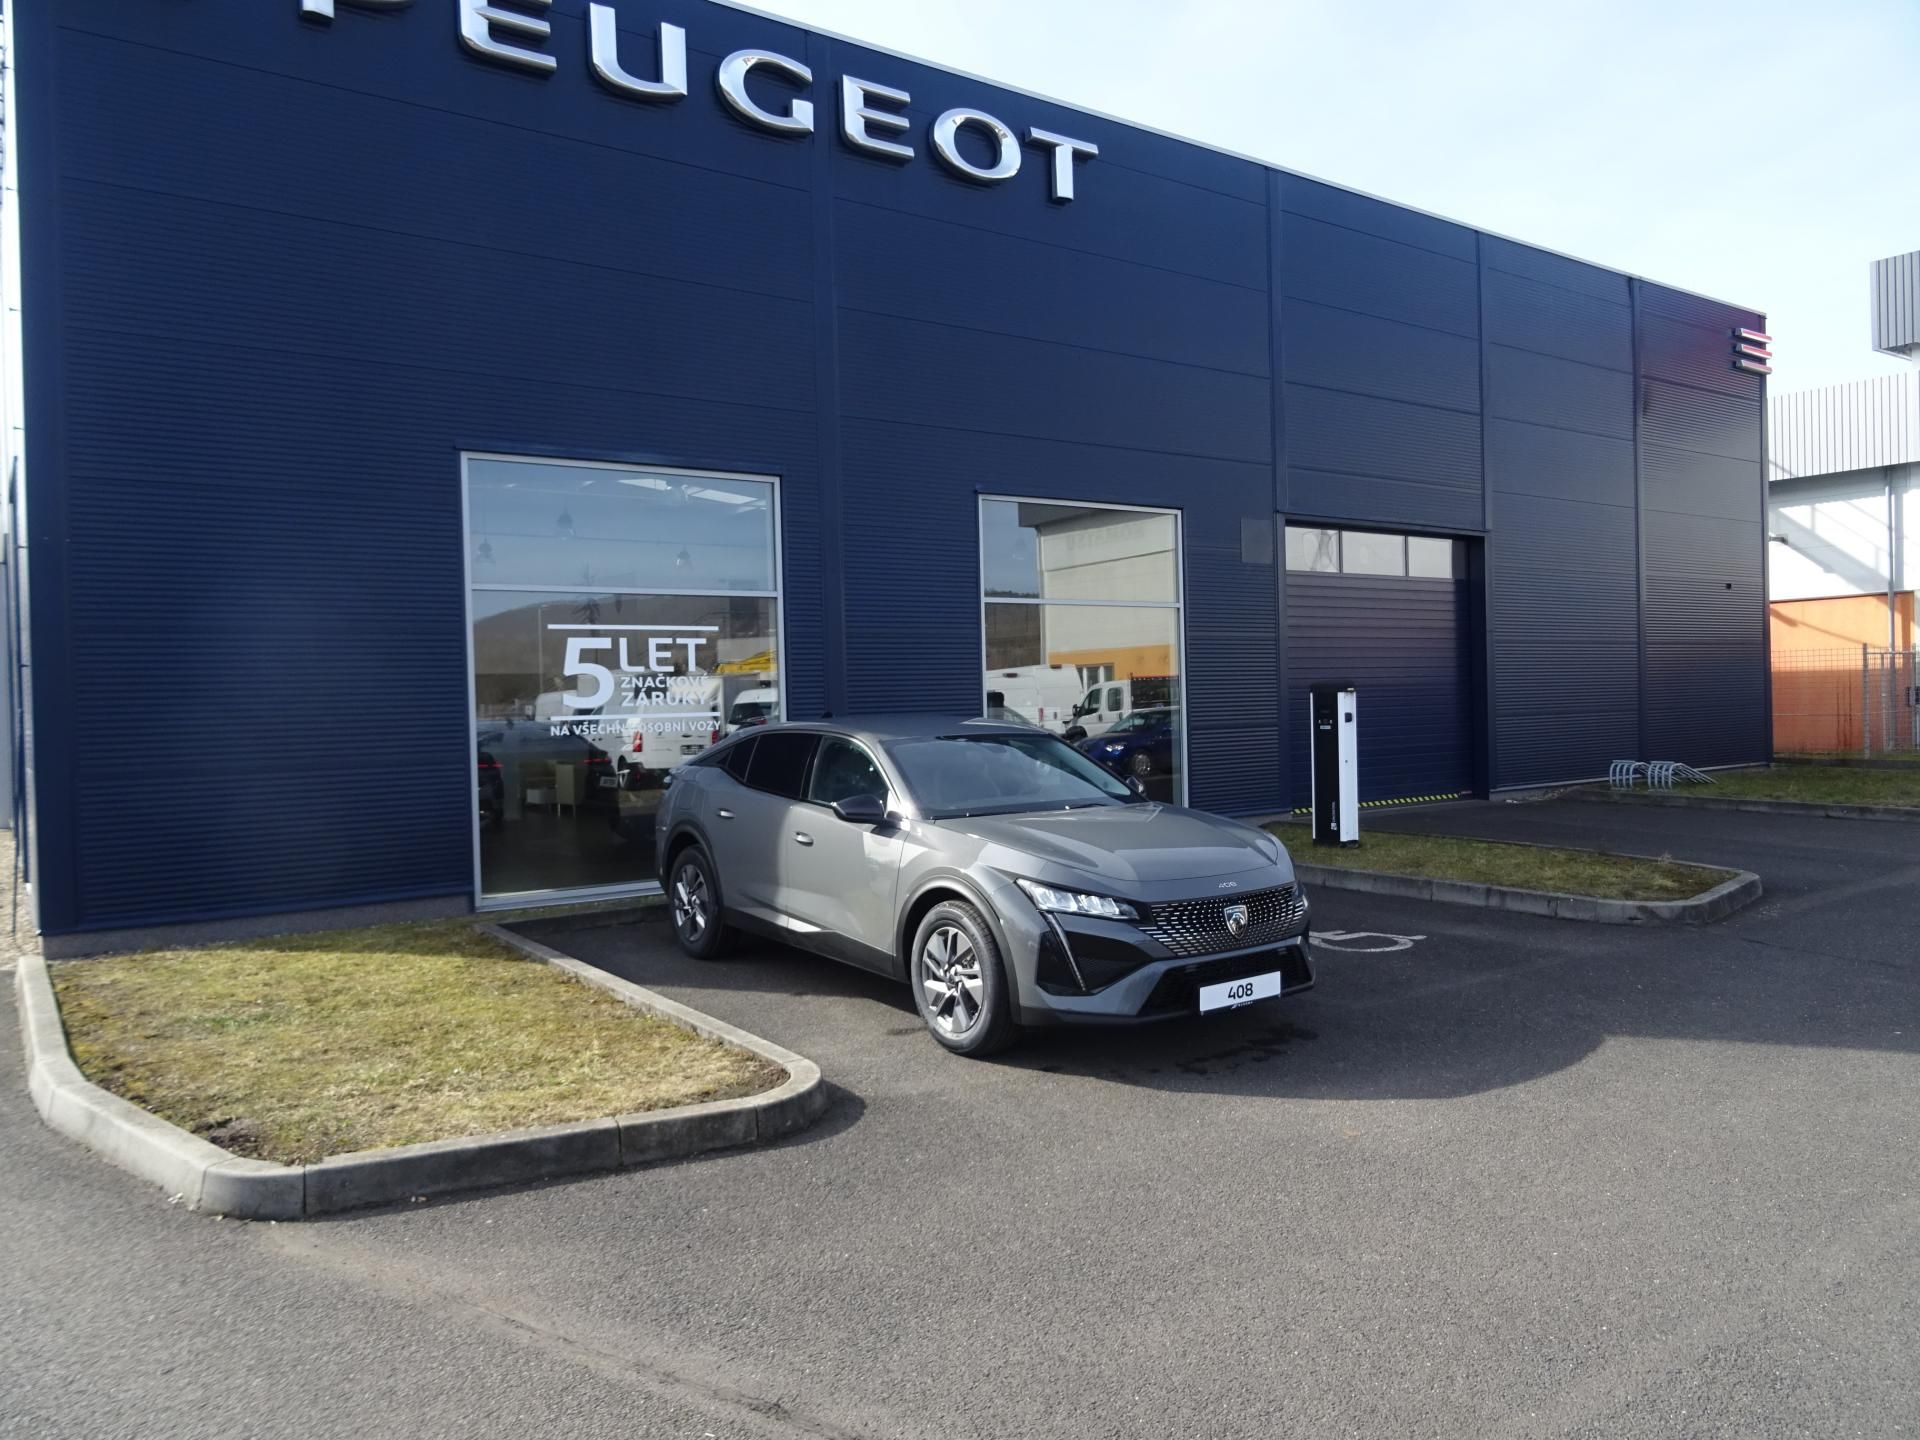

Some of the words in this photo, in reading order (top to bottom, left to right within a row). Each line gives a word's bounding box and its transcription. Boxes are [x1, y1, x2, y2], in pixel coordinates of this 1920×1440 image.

[301, 0, 1098, 202] EUGEOT
[562, 637, 615, 709] 5
[619, 637, 707, 673] LET
[621, 689, 707, 707] ZÁRUKY
[550, 725, 570, 737] NA
[572, 722, 634, 736] VŠECHN
[690, 720, 721, 732] VOZY
[1227, 982, 1254, 1000] 408
